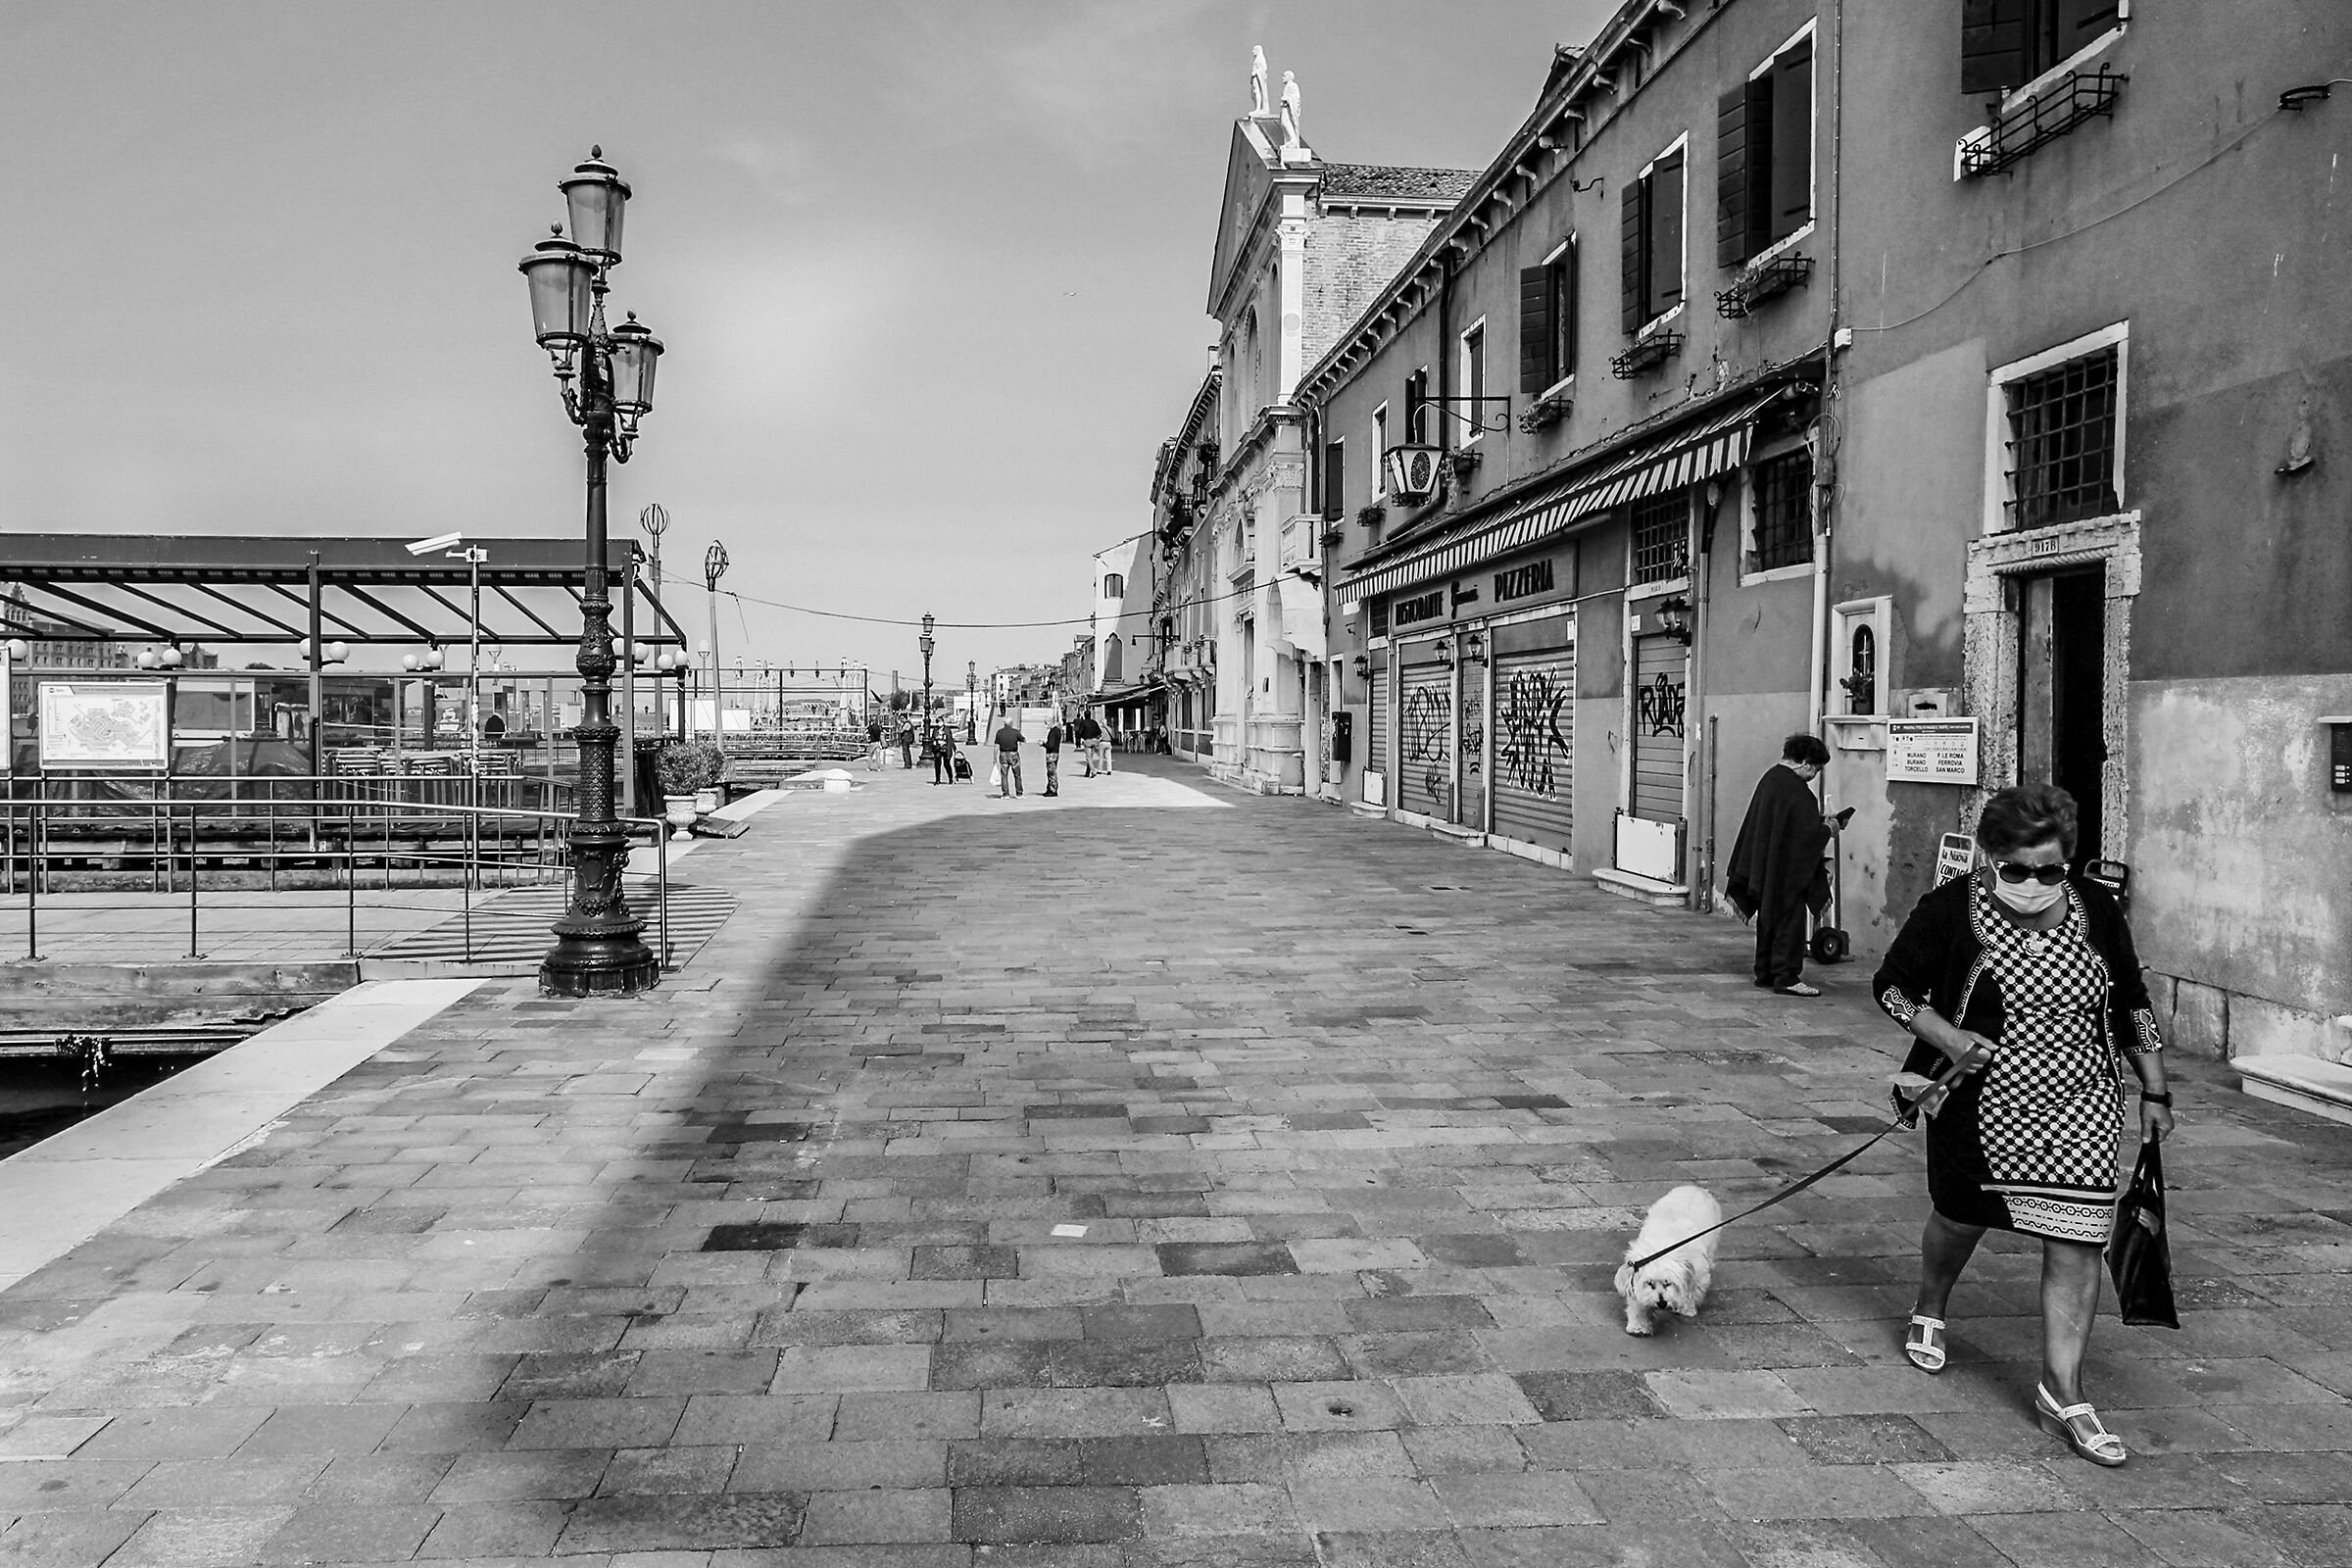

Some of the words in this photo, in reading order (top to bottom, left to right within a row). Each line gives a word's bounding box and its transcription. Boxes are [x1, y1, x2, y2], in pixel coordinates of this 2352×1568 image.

[1396, 591, 1444, 625] RISTORANTE
[1494, 559, 1554, 603] PIZZERIA
[1941, 849, 1948, 859] la
[1950, 850, 1969, 863] Nuova
